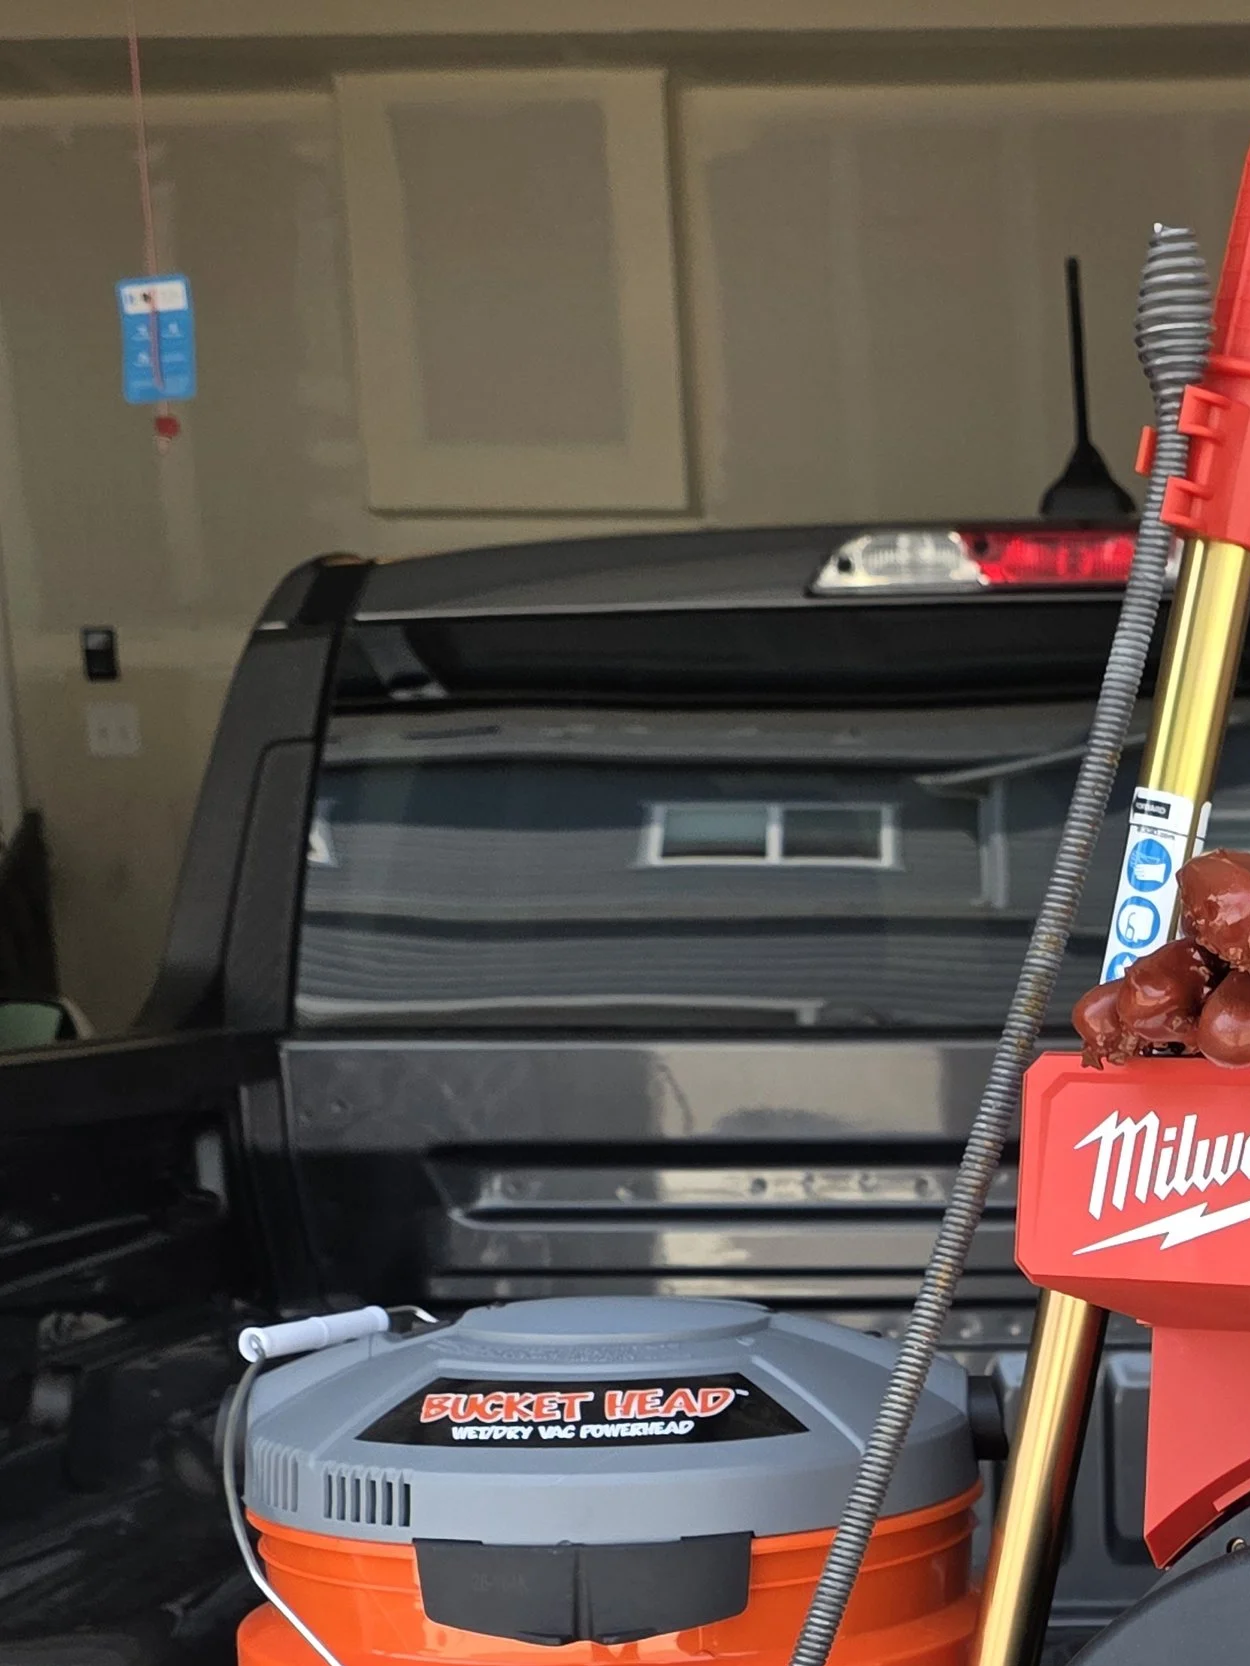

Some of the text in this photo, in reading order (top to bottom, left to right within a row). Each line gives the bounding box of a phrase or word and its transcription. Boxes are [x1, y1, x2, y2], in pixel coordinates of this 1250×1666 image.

[420, 1388, 736, 1423] BUCKET HEAD
[451, 1420, 695, 1440] WET/DRY VAC POWERHEAD
